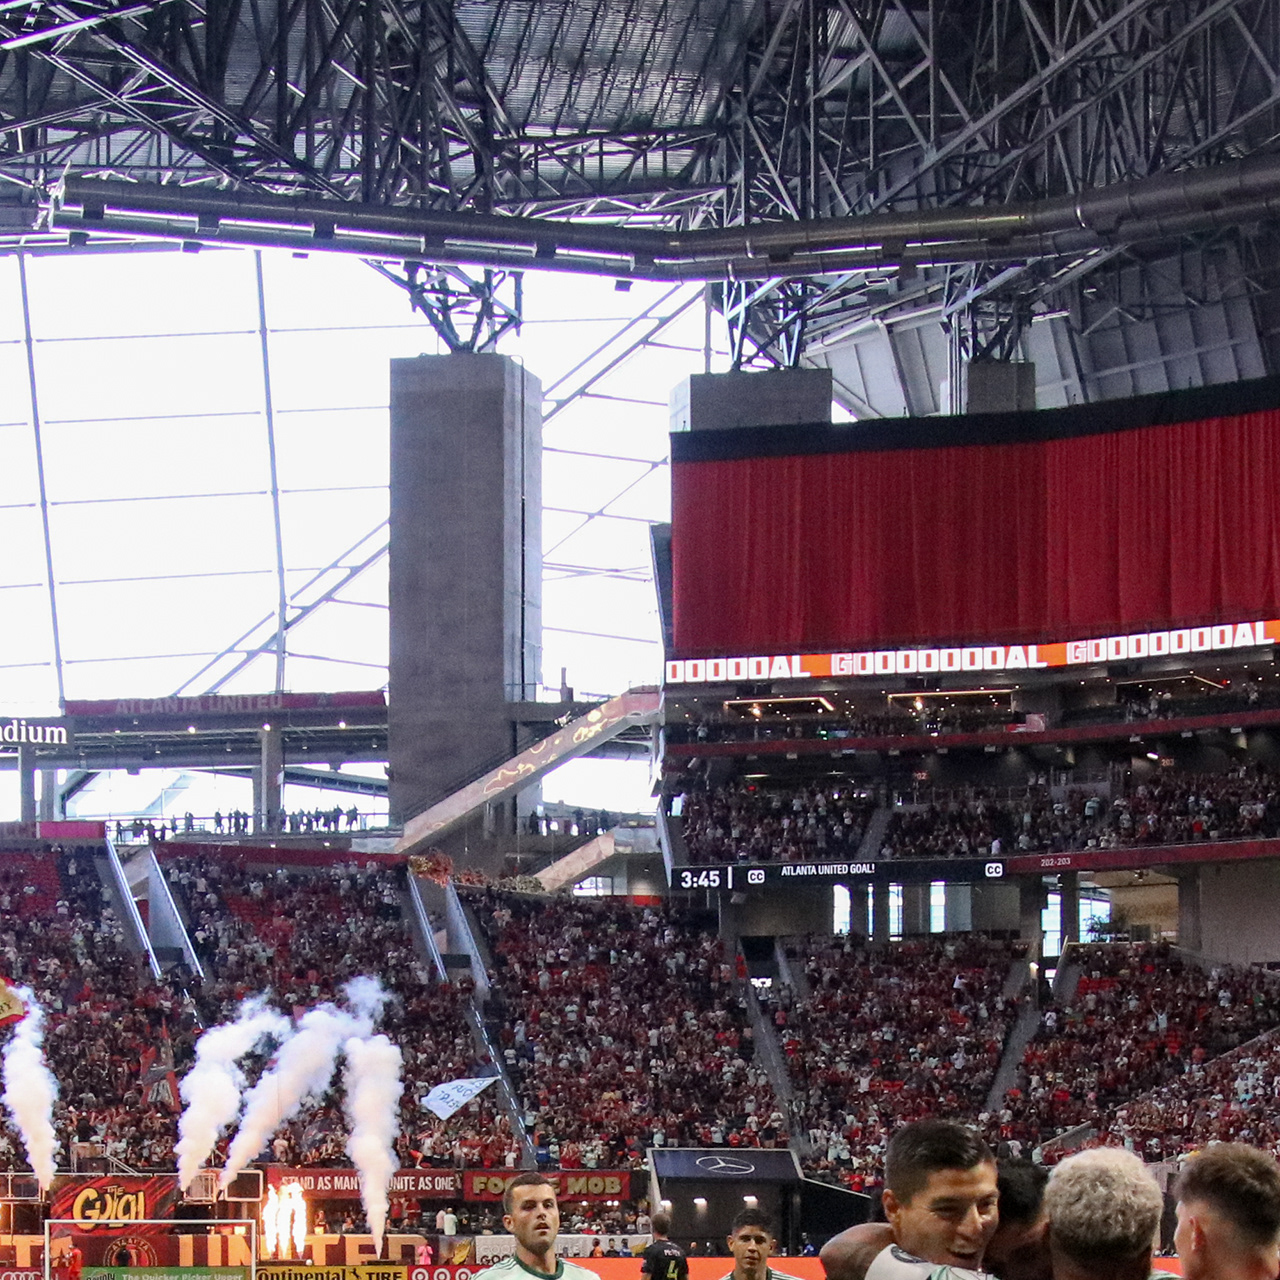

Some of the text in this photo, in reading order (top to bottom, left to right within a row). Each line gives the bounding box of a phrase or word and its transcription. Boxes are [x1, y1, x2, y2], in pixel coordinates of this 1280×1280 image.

[781, 862, 875, 877] ATLANTA UNITED GOAL!
[681, 870, 720, 888] 3:45
[317, 1176, 332, 1190] AS
[334, 1175, 361, 1190] MANY
[418, 1175, 433, 1190] AS
[435, 1175, 454, 1190] ONE
[567, 1176, 621, 1195] MOB
